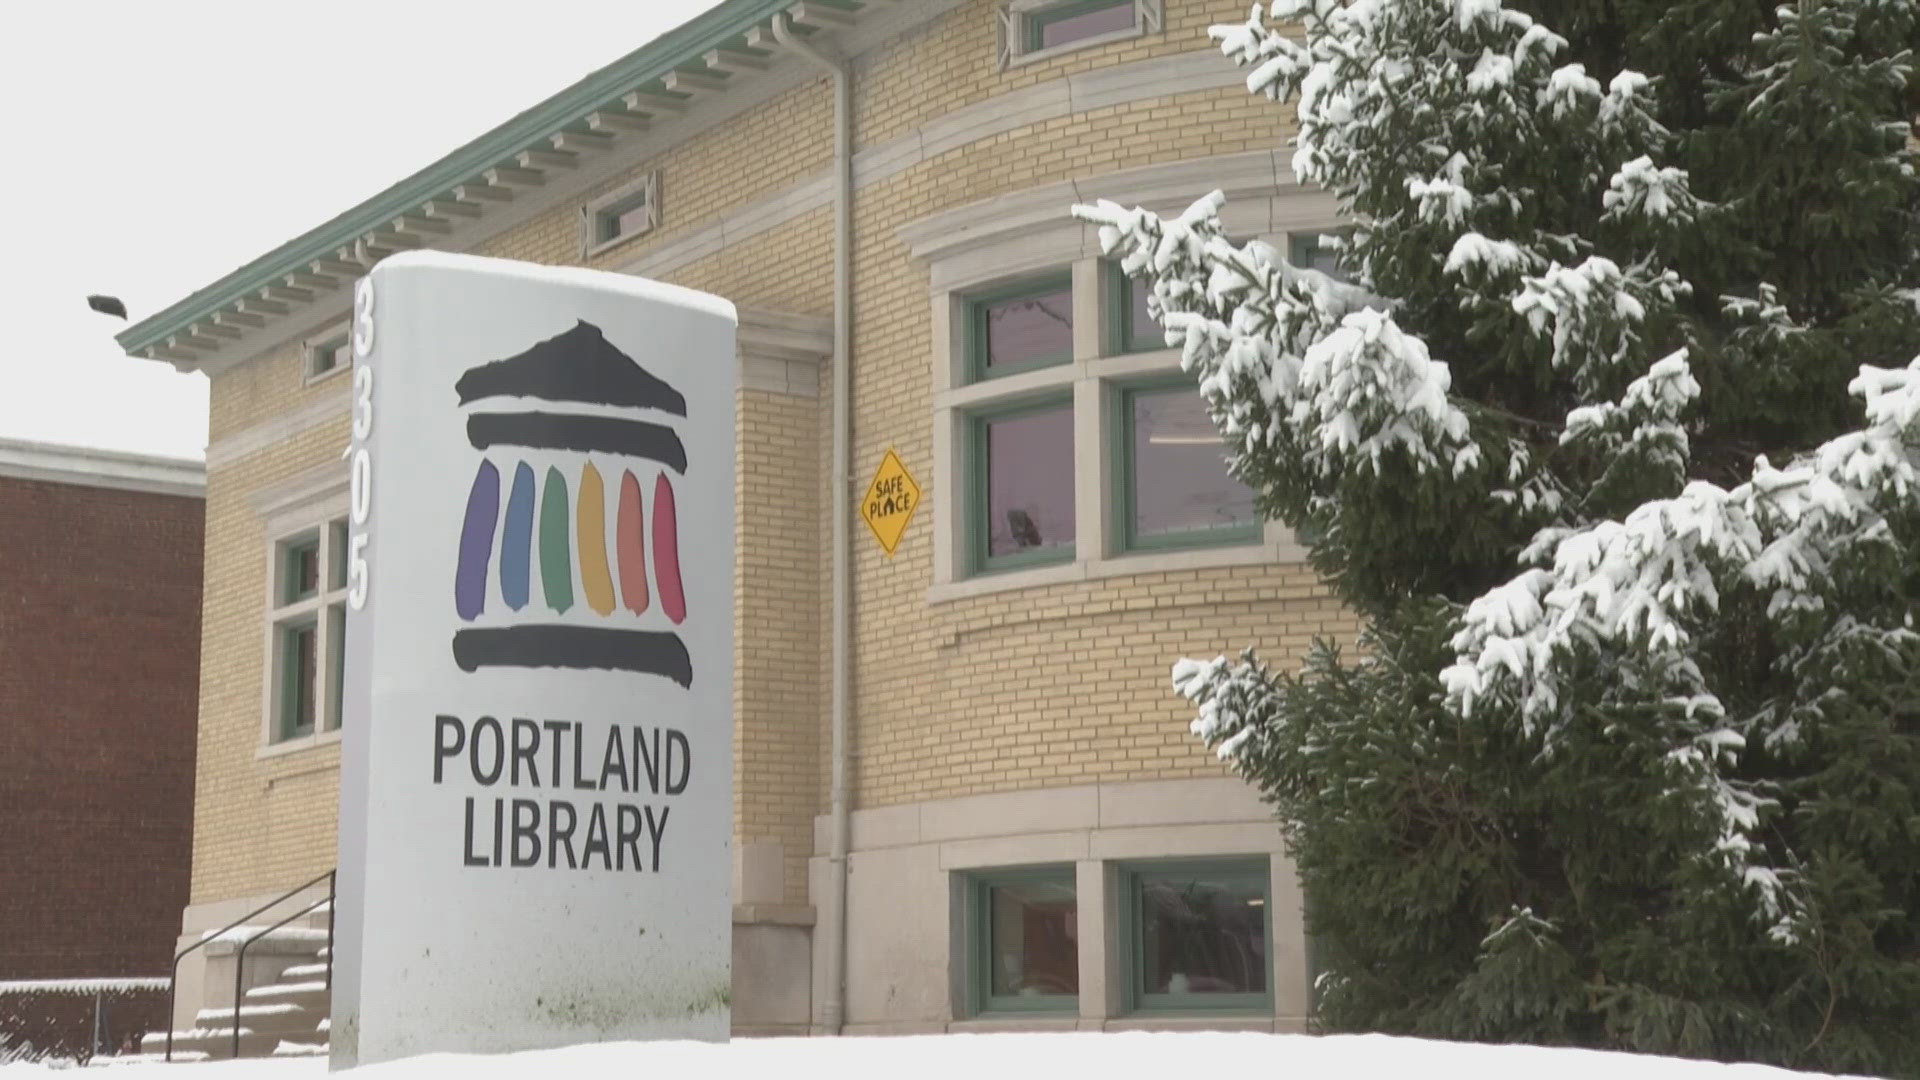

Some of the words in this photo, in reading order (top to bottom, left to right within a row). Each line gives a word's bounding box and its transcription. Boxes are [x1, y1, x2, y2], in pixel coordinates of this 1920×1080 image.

[350, 275, 375, 611] 3305
[870, 492, 910, 520] PLACE
[875, 475, 903, 499] SAFE
[433, 714, 691, 796] PORTLAND
[464, 796, 670, 873] LIBRARY
